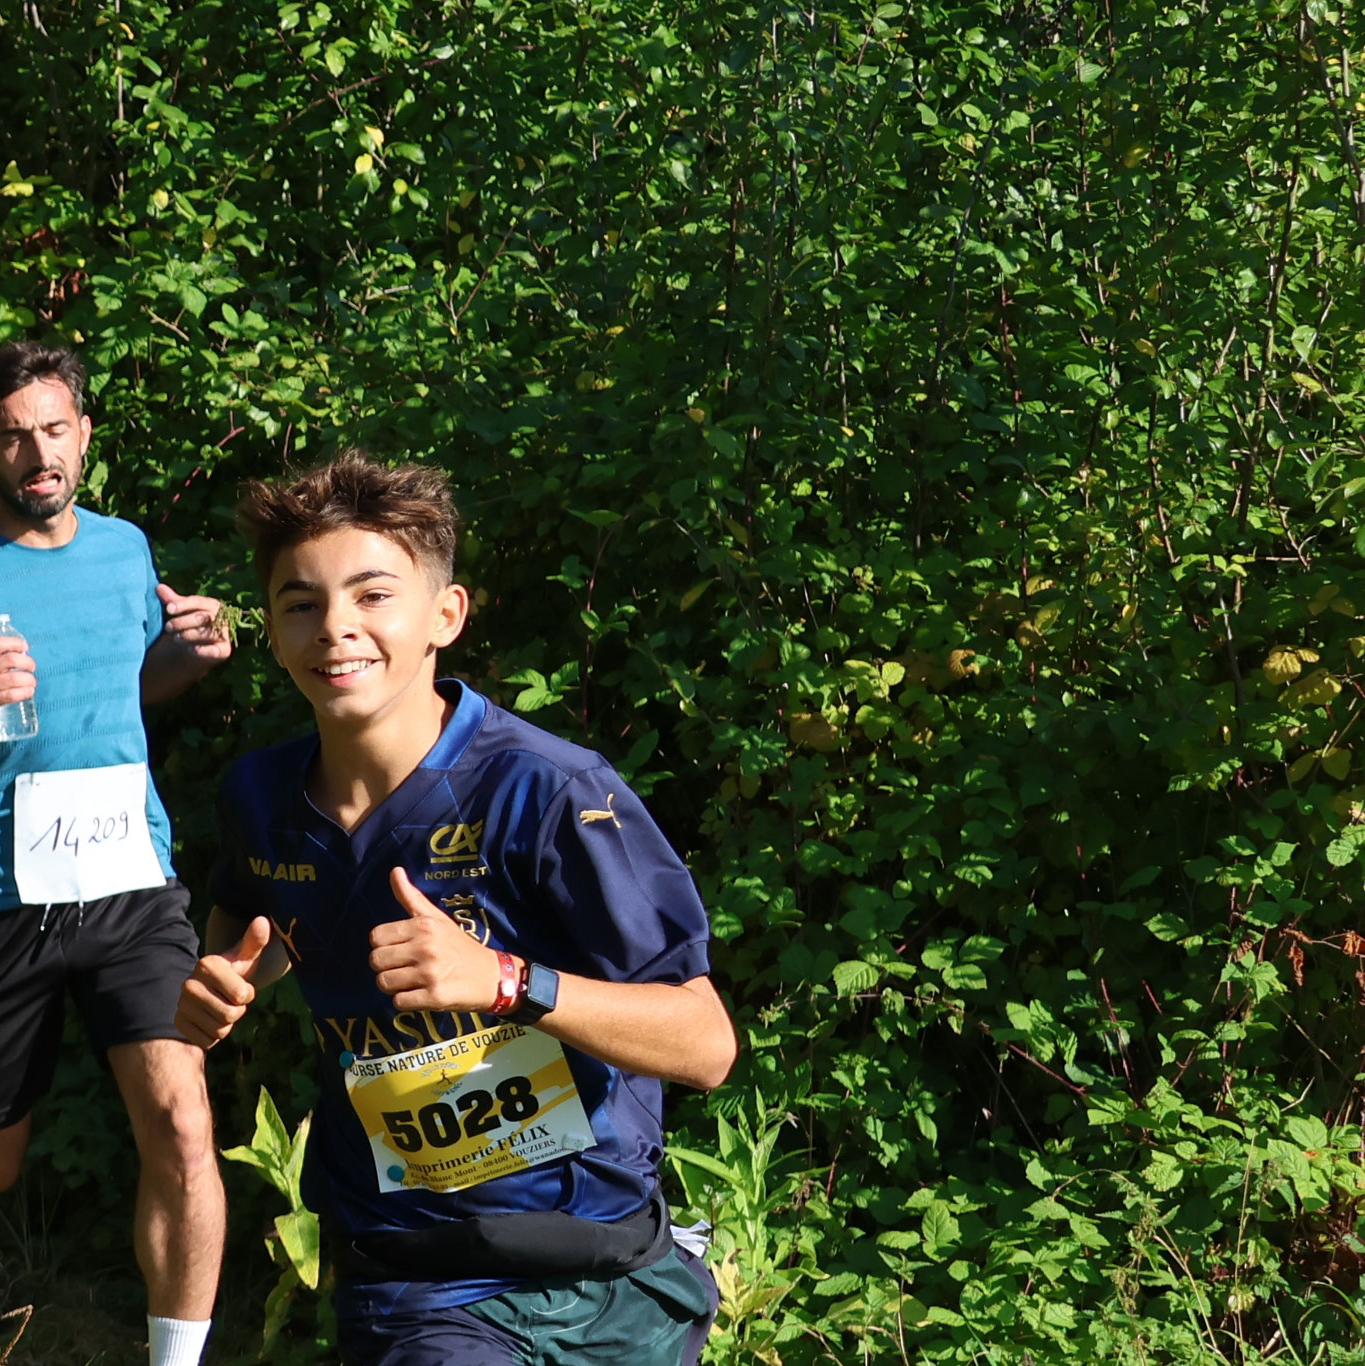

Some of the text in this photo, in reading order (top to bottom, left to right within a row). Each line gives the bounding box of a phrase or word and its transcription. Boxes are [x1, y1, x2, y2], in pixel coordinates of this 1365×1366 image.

[425, 866, 487, 880] NORD EST
[387, 1048, 446, 1073] NATURE
[451, 1041, 469, 1057] DE
[472, 1025, 527, 1048] VOUZIE
[380, 1075, 539, 1152] 5028
[496, 1124, 550, 1151] FÉLIX
[510, 1139, 556, 1158] VOUZIERS
